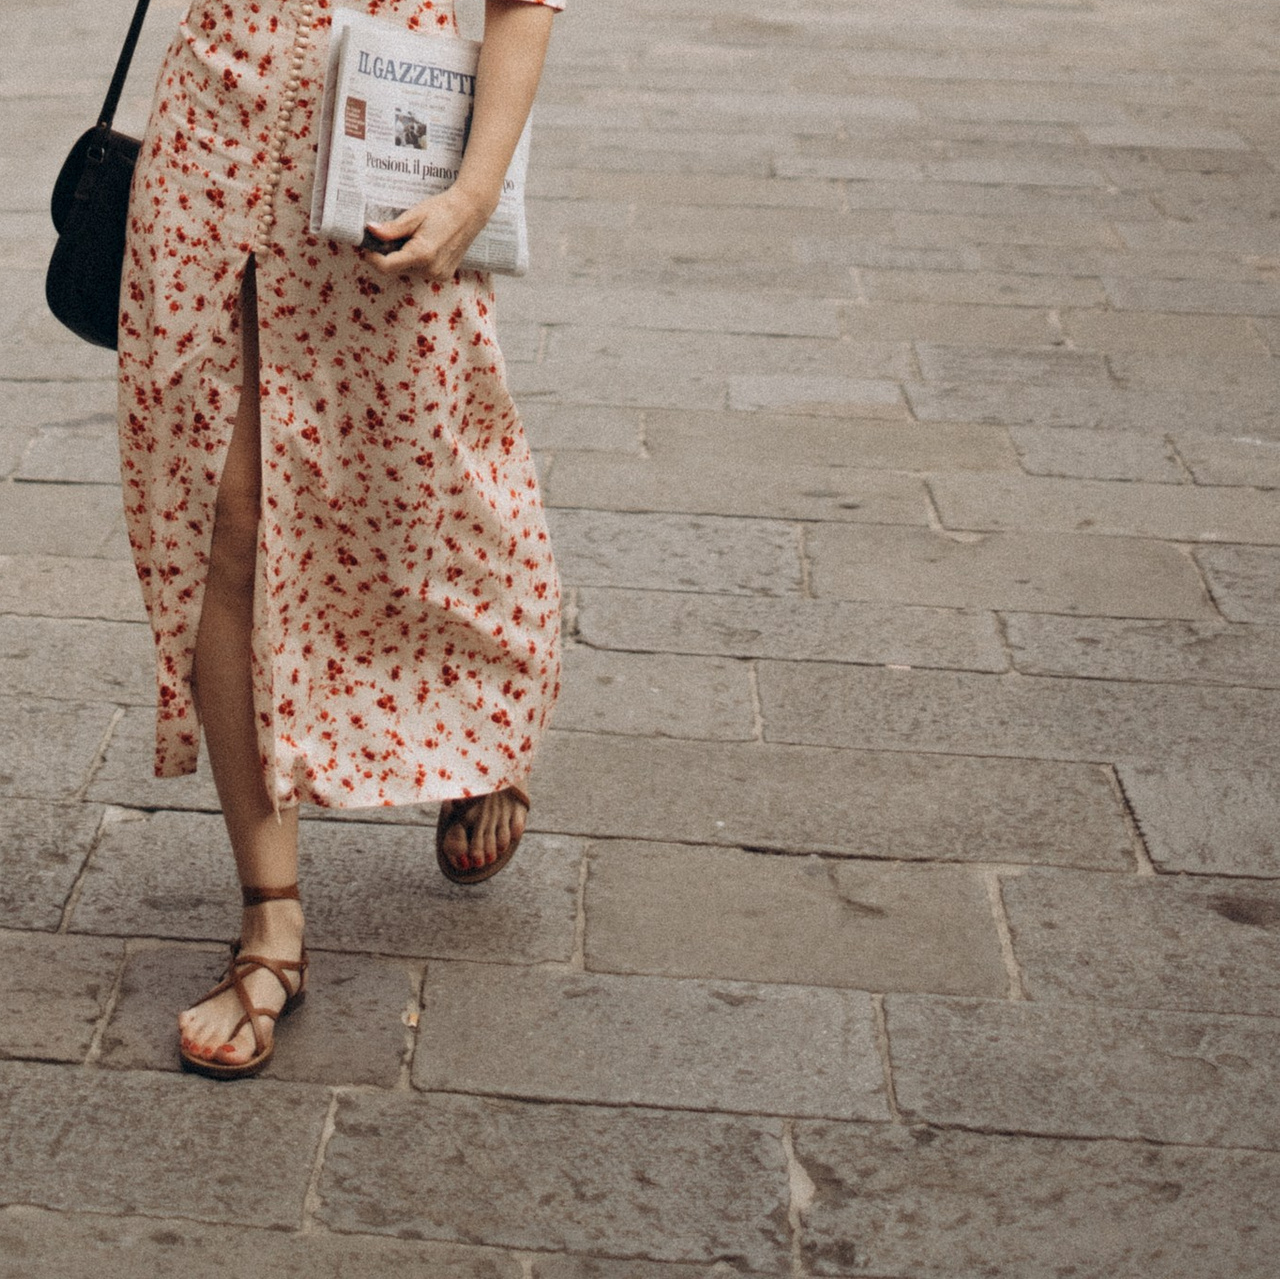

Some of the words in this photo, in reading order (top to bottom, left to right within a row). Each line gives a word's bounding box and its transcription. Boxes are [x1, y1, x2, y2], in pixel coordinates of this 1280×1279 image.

[358, 50, 371, 75] IL
[366, 152, 411, 174] Pensioni,
[412, 158, 420, 175] il
[422, 162, 452, 180] piano
